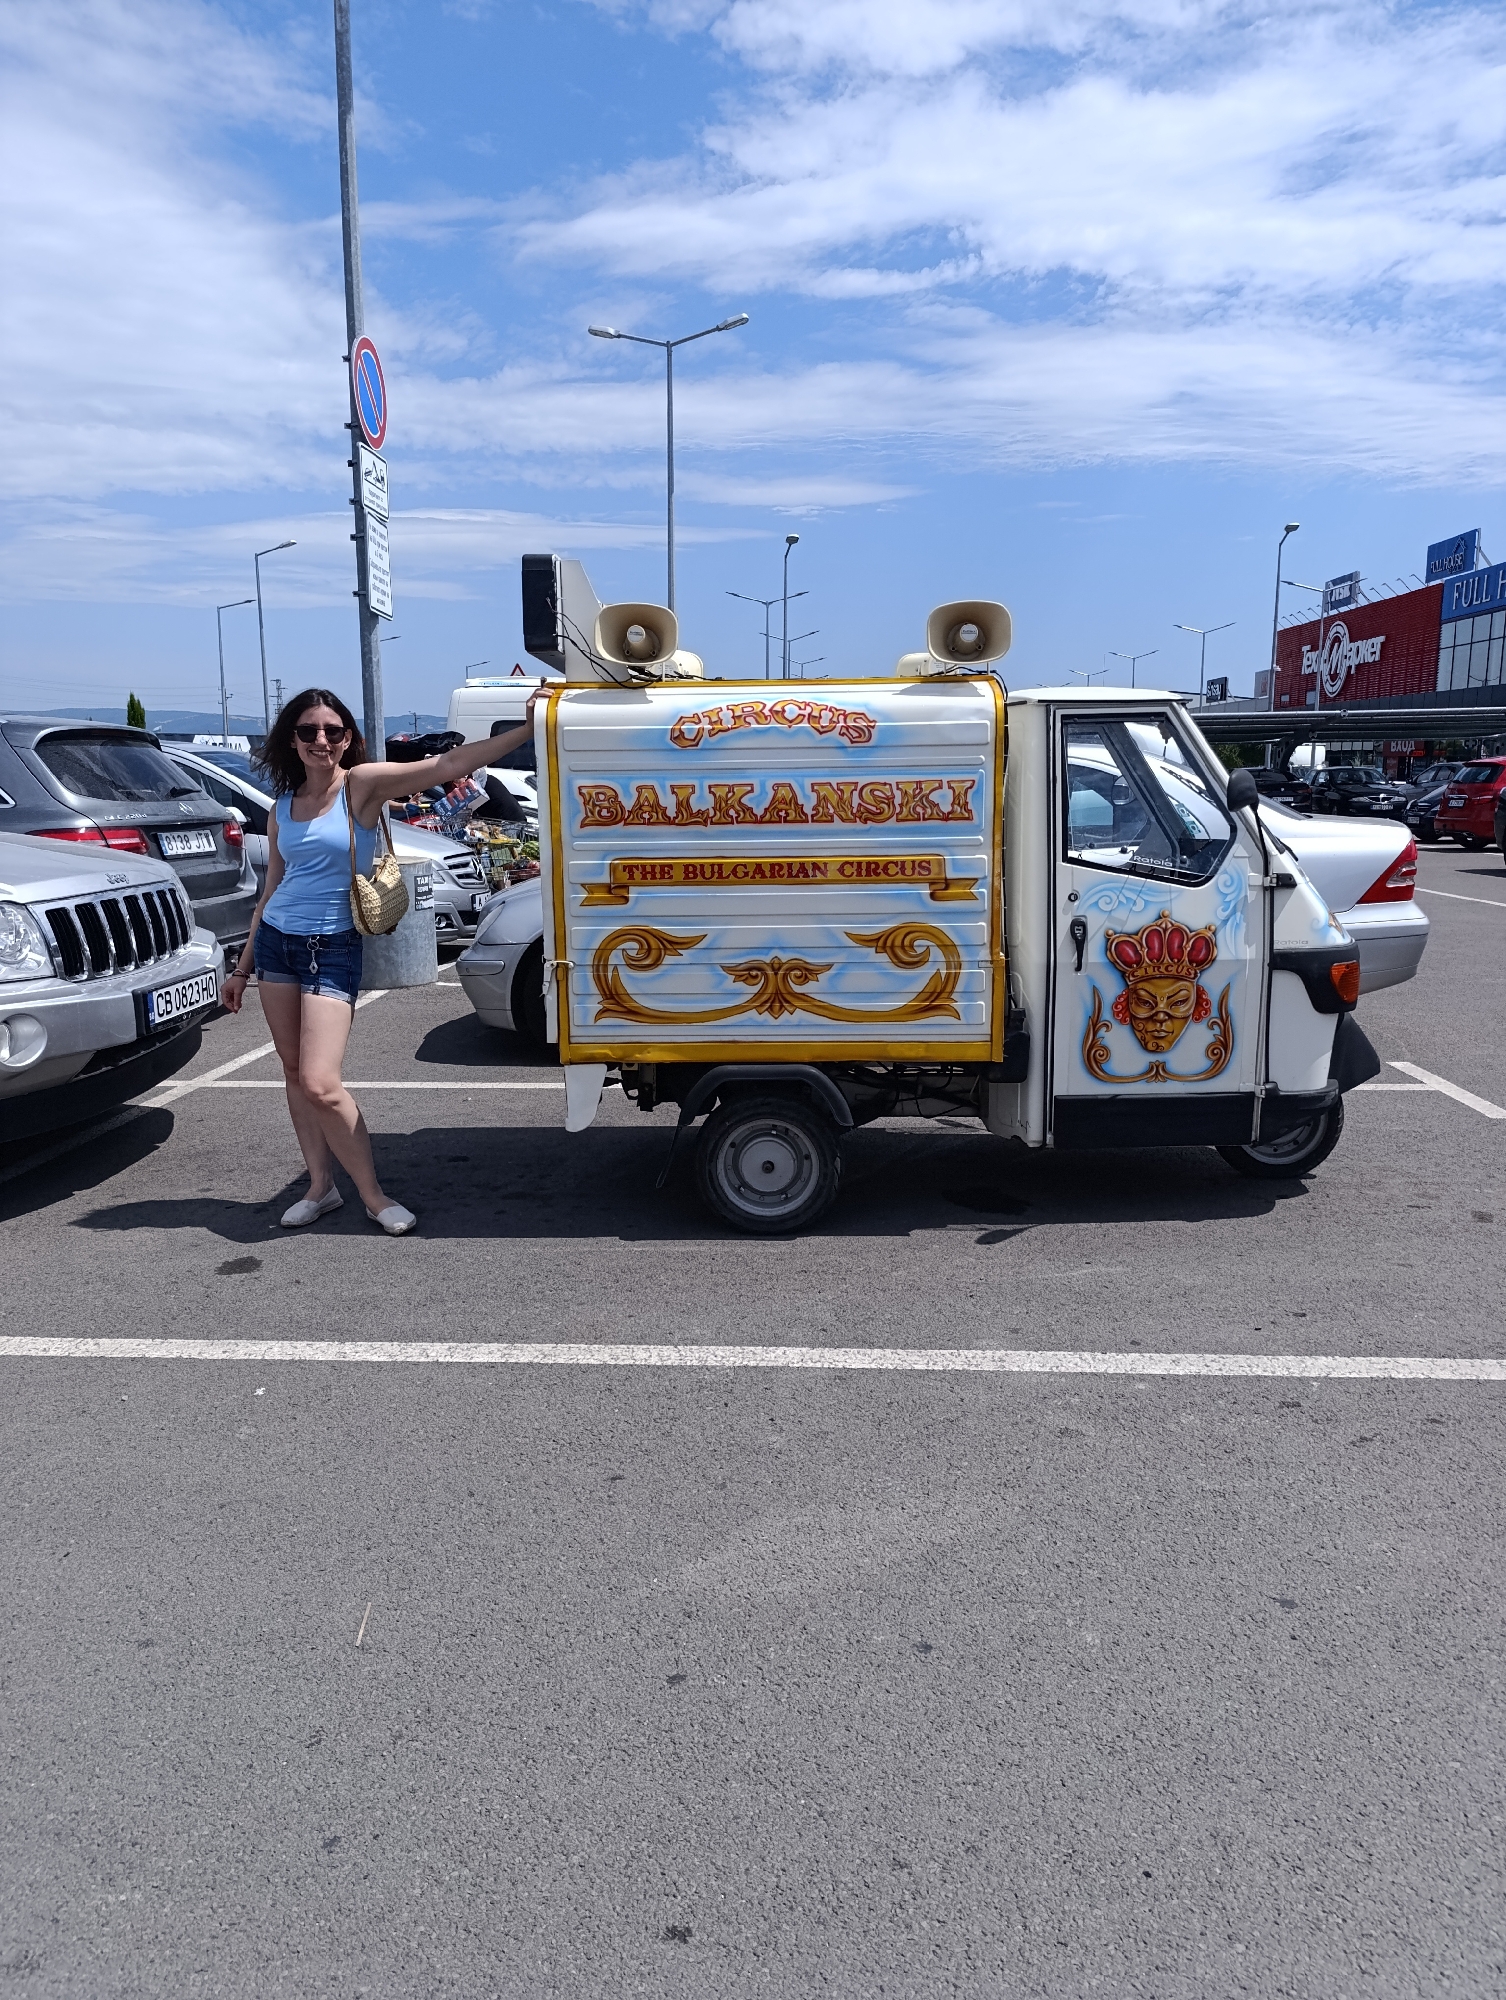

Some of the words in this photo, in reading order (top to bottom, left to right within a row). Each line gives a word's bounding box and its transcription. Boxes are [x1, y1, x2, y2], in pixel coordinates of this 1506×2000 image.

[1452, 574, 1491, 610] FULL
[670, 699, 877, 748] CIRCUS
[578, 779, 975, 829] BALKANSKI
[165, 833, 192, 851] 8138
[622, 864, 674, 881] THE
[682, 862, 829, 881] BULGARIAN
[836, 860, 932, 878] CIRCUS
[1131, 964, 1193, 978] CIRCUS
[156, 990, 173, 1018] CB
[174, 980, 200, 1011] 0823
